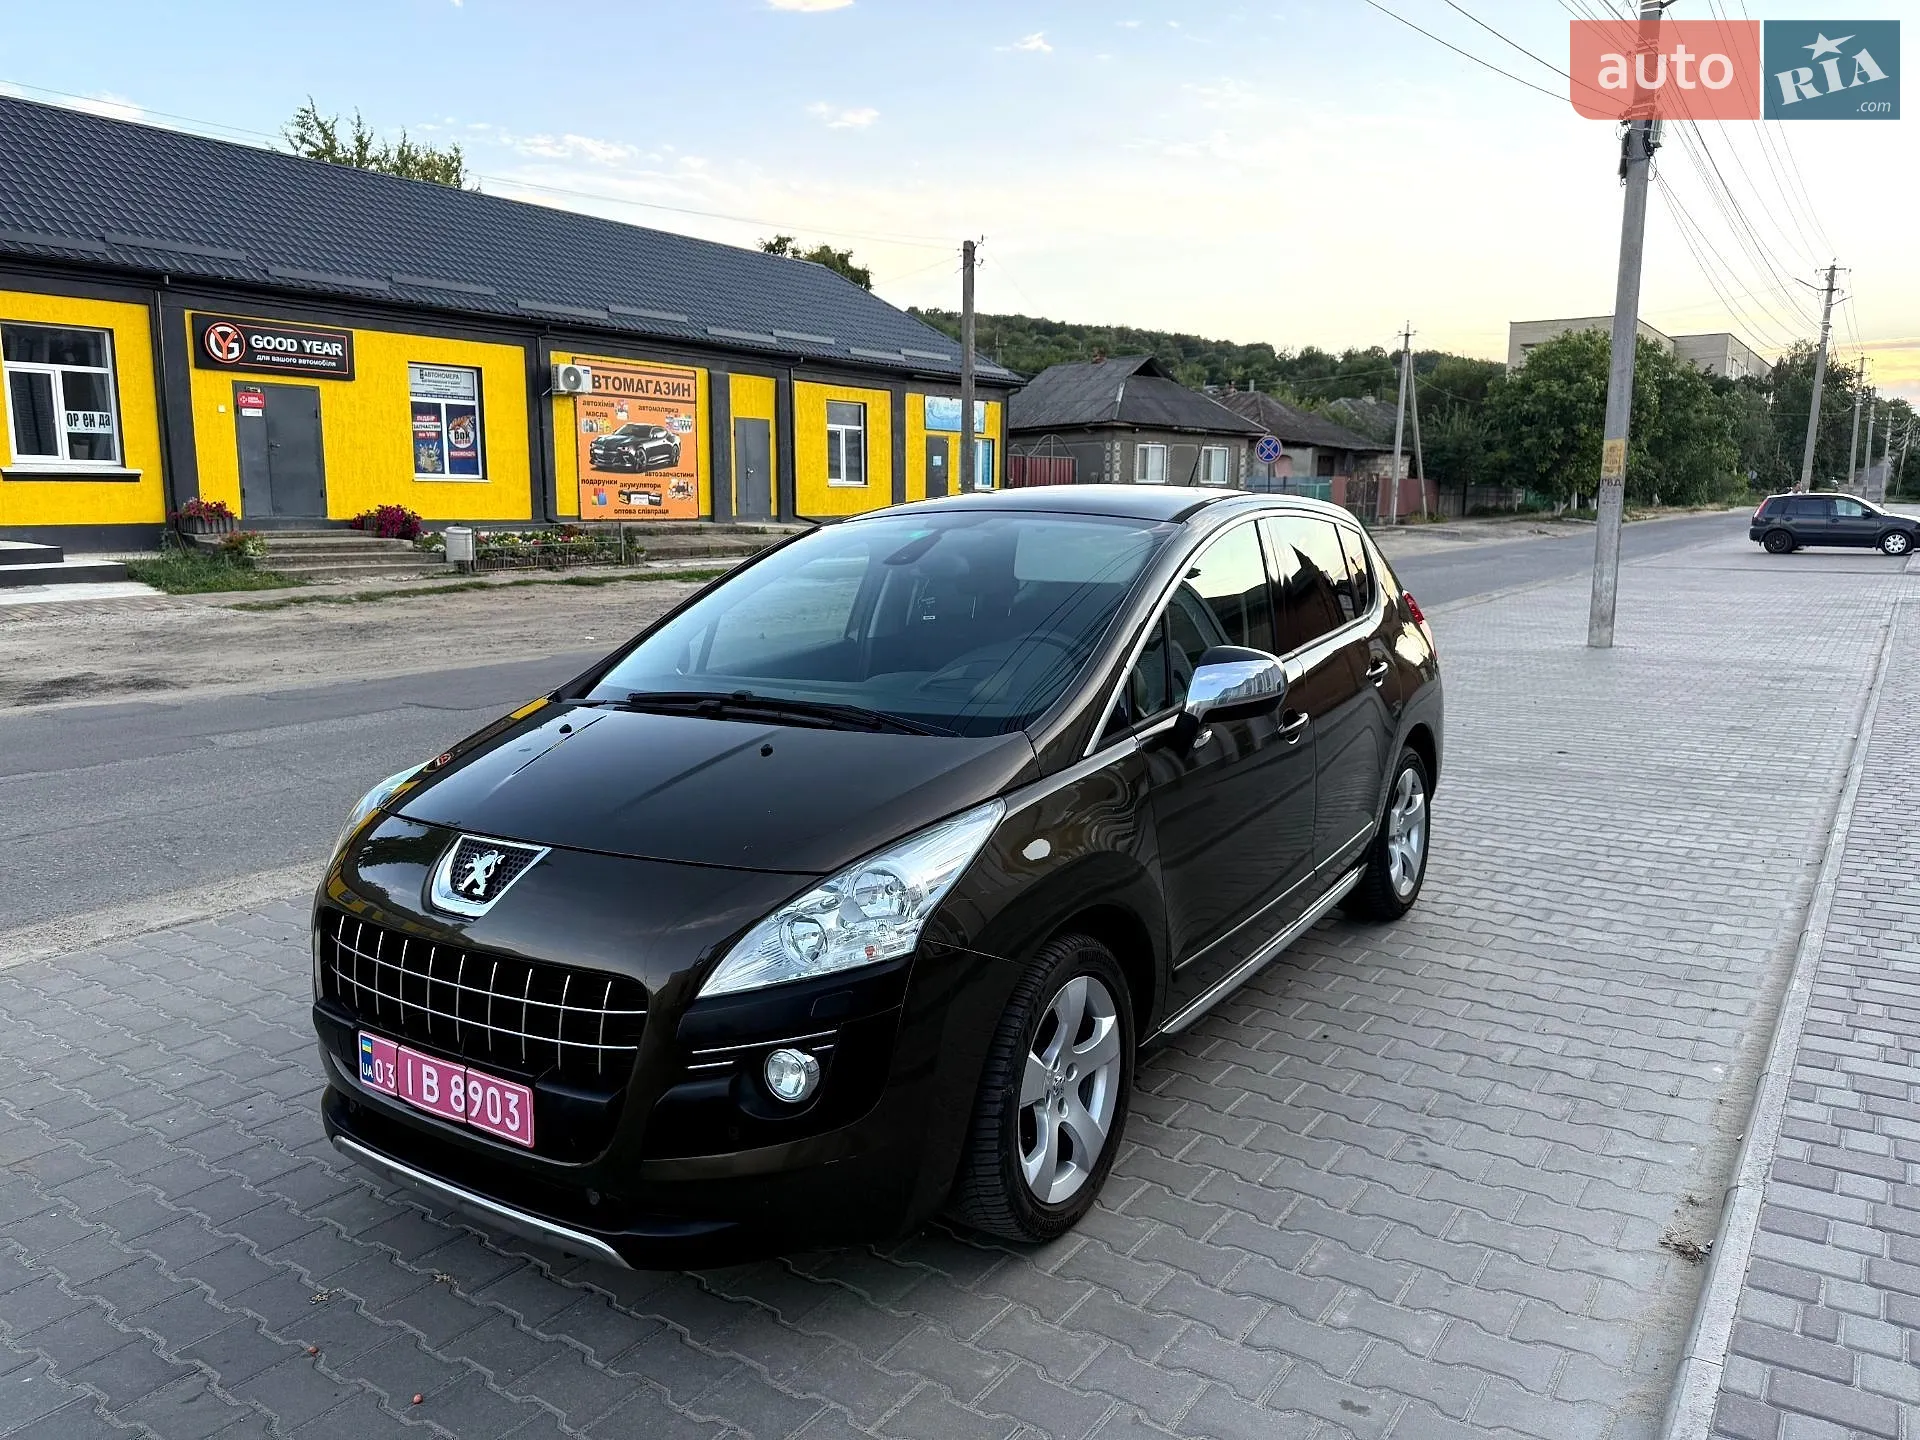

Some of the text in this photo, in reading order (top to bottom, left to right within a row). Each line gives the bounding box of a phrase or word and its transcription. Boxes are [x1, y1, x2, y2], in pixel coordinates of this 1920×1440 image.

[250, 335, 343, 356] GOOD YEAR
[256, 354, 336, 367] для вашого автомобіля
[591, 374, 691, 397] ВТОМАГАЗИН
[582, 399, 615, 408] автохімія
[585, 410, 608, 418] масла
[638, 405, 679, 414] автомалярка
[581, 478, 618, 487] подарунки
[619, 482, 662, 490] акумулятори
[637, 508, 670, 516] співпраця
[362, 1062, 374, 1079] UA
[374, 1058, 396, 1089] 03
[449, 1074, 521, 1132] 8903
